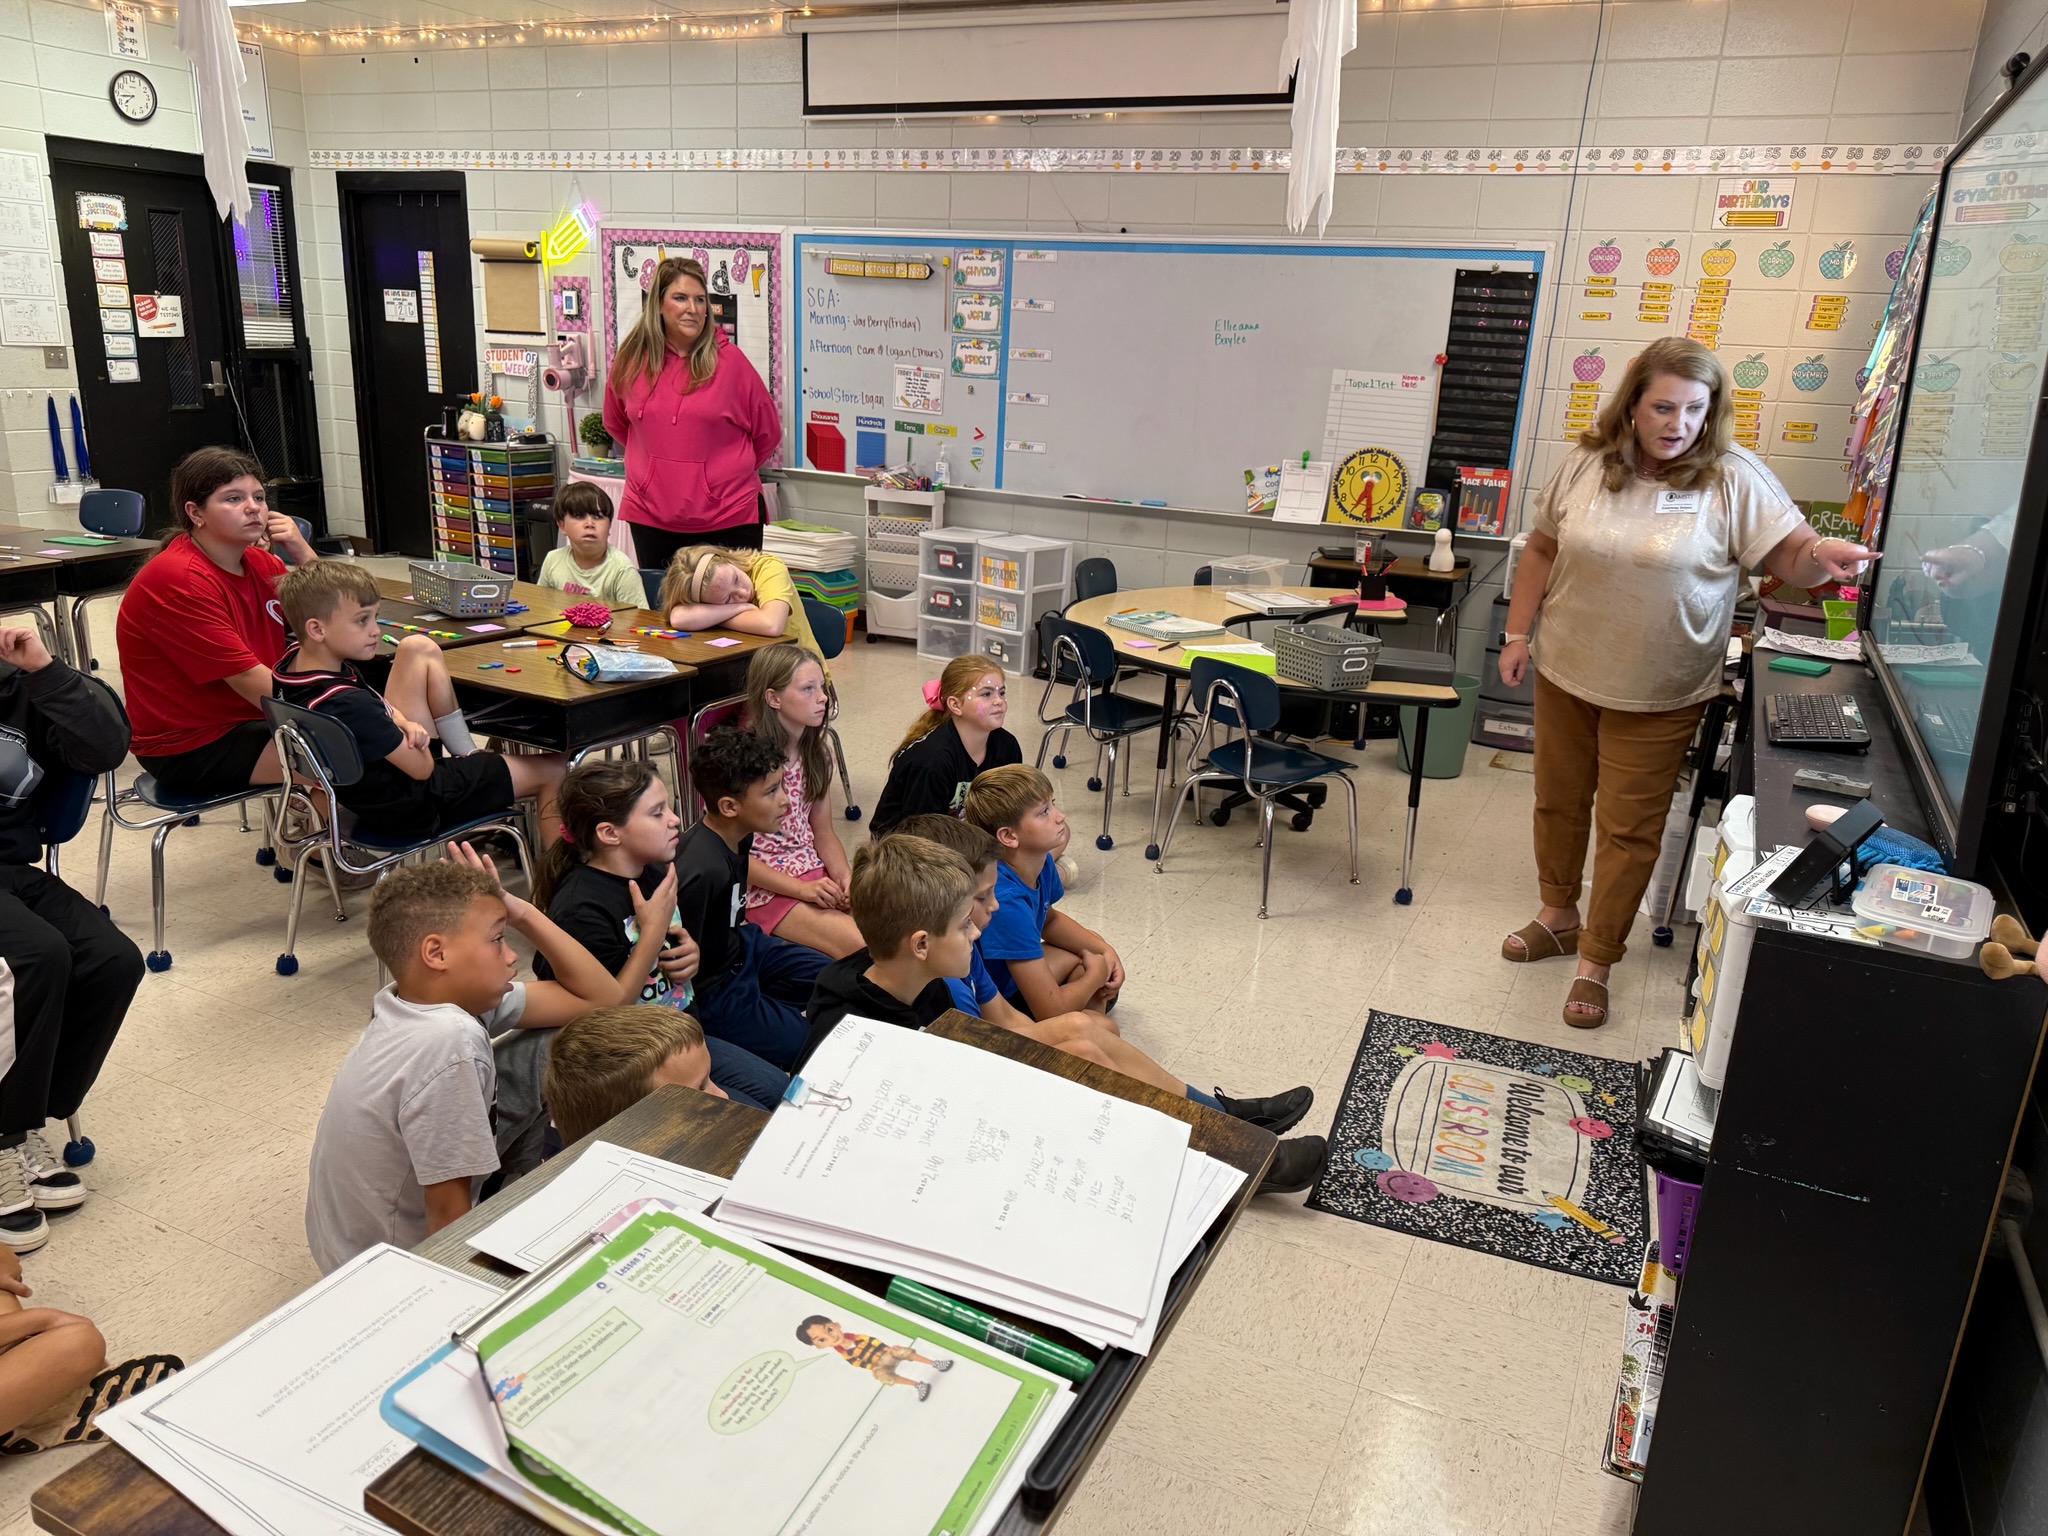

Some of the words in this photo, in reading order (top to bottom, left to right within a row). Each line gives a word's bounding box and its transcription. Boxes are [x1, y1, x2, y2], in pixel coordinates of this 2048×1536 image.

[1169, 151, 1181, 161] 29
[1190, 150, 1203, 161] 30
[1210, 150, 1221, 161] 31
[1228, 150, 1241, 161] 32
[1398, 150, 1412, 161] 40
[1444, 150, 1458, 161] 42
[1466, 149, 1480, 161] 43
[1487, 150, 1502, 161] 44
[1513, 150, 1529, 161] 45
[1536, 150, 1551, 161] 46
[1585, 149, 1601, 161] 48
[1609, 149, 1625, 160] 49
[1632, 149, 1648, 160] 50
[1662, 149, 1678, 160] 51
[1710, 148, 1726, 160] 53
[1740, 148, 1756, 160] 54
[1765, 148, 1782, 160] 55
[1790, 148, 1806, 160] 56
[1821, 148, 1838, 160] 57
[1846, 148, 1864, 160] 58
[1872, 148, 1891, 160] 59
[1904, 148, 1922, 160] 60
[1742, 180, 1770, 194] OUR
[1718, 195, 1789, 209] BIRTHDAYS
[1646, 255, 1679, 263] FEBRUARY
[1767, 256, 1784, 264] APRIL
[833, 262, 864, 272] THURSDAY
[865, 265, 894, 274] OCTOBER
[908, 267, 925, 276] 2025
[807, 287, 840, 309] SGA:
[398, 306, 404, 315] 2
[810, 311, 850, 331] Morning:
[486, 350, 524, 361] STUDENT
[526, 353, 536, 363] OF
[492, 363, 504, 371] THE
[505, 362, 528, 375] WEEK
[1582, 362, 1597, 370] JULY
[1736, 368, 1766, 376] OCTOBER
[1792, 370, 1828, 378] NOVEMBER
[1345, 378, 1368, 389] Topic
[809, 387, 834, 400] School
[861, 392, 884, 409] Logan
[812, 413, 839, 422] Thousands
[858, 417, 883, 427] Hundreds
[1359, 457, 1365, 466] 11
[1370, 454, 1379, 463] 12
[1385, 458, 1390, 467] 1
[1345, 466, 1355, 476] 10
[1393, 469, 1400, 478] 2
[1339, 479, 1345, 488] 9
[1460, 476, 1480, 486] PLACE
[1483, 478, 1508, 488] VALUE
[1395, 484, 1402, 492] 3
[1340, 493, 1347, 502] 8
[1388, 498, 1395, 506] 4
[1377, 506, 1384, 515] 5
[1496, 723, 1522, 734] Extra
[1506, 1081, 1546, 1149] Welcome
[1431, 1073, 1495, 1178] CLASSROOM
[1509, 1146, 1533, 1165] to
[1497, 1163, 1529, 1196] our
[616, 1255, 639, 1276] Lesson
[638, 1246, 651, 1258] 3-1
[628, 1259, 653, 1281] Multiply
[652, 1252, 662, 1262] by
[660, 1232, 686, 1254] Multiples
[637, 1279, 645, 1287] of
[644, 1271, 654, 1282] 10,
[653, 1262, 666, 1274] 100,
[665, 1252, 677, 1264] and
[677, 1238, 692, 1253] 1,000
[668, 1291, 677, 1300] can
[732, 1407, 740, 1416] can
